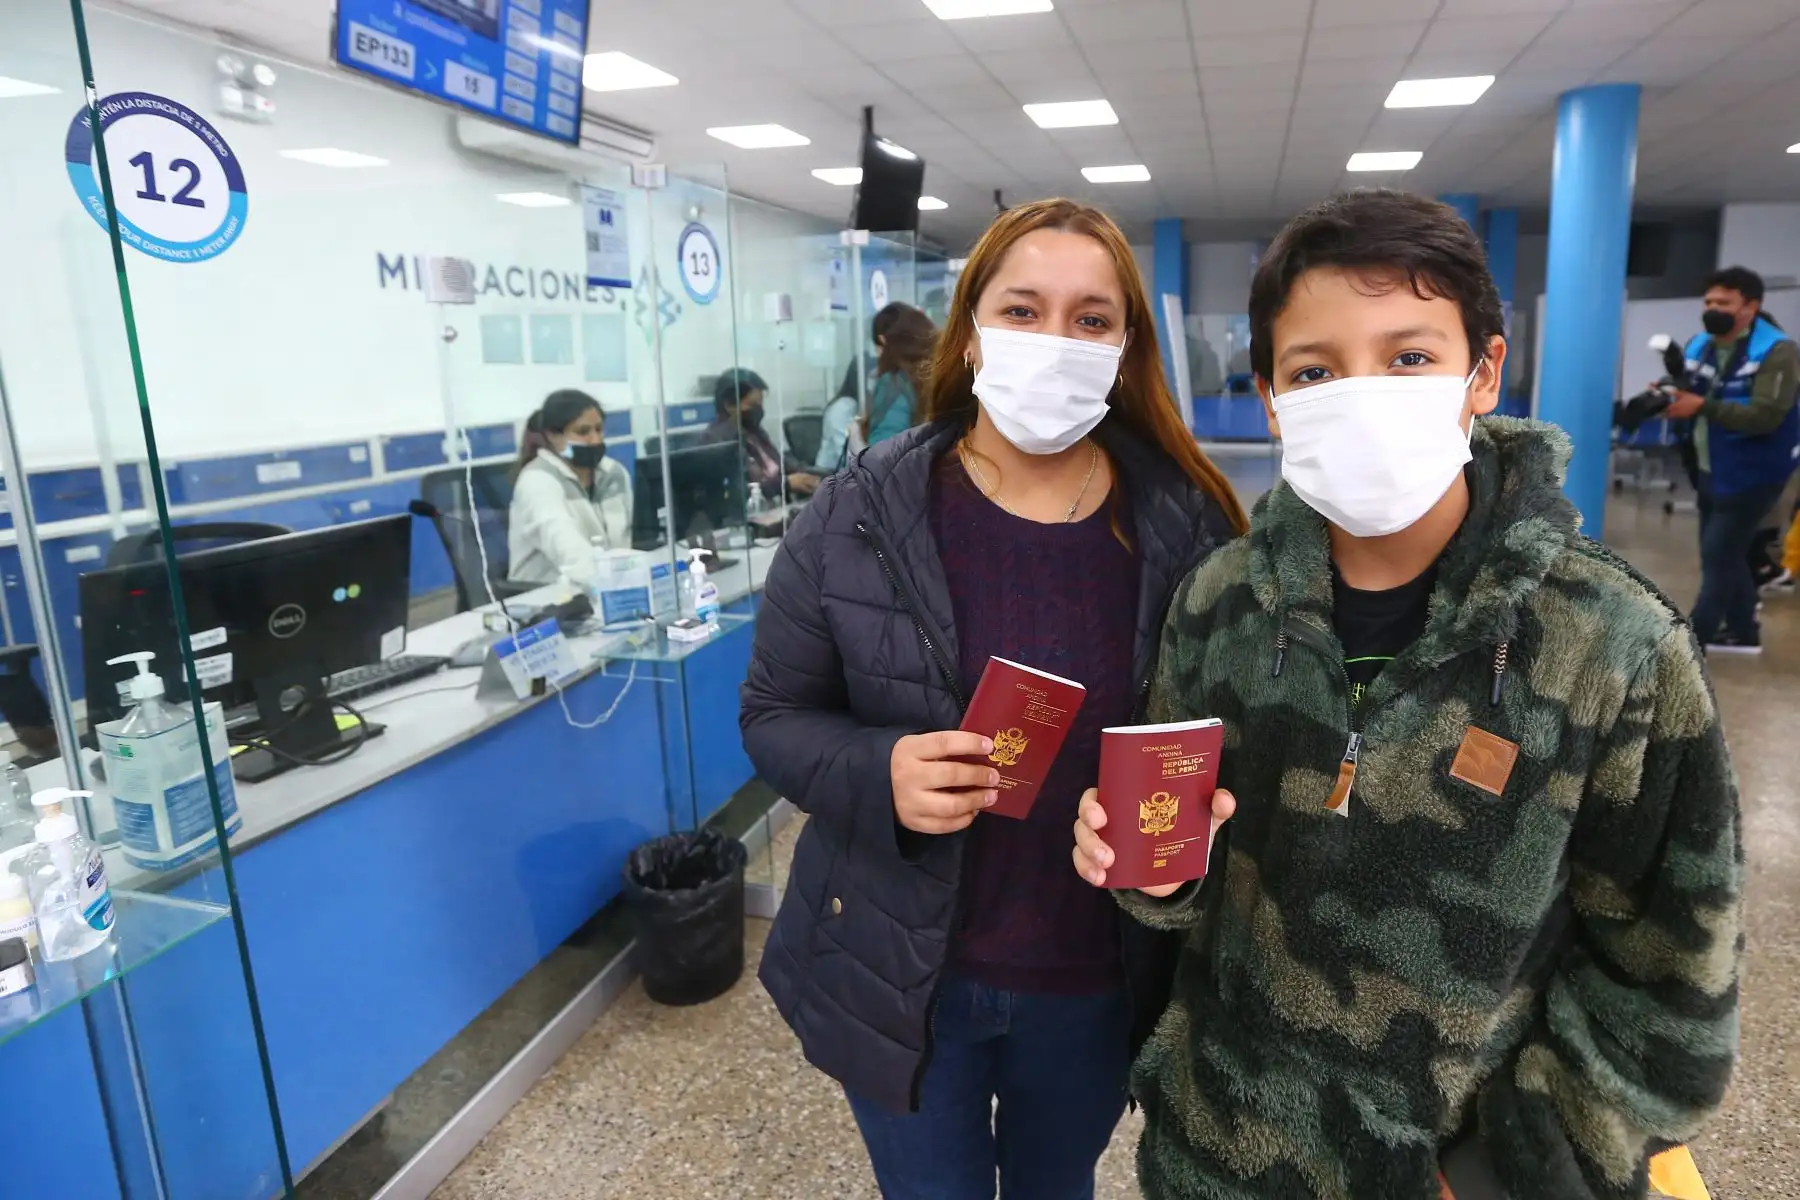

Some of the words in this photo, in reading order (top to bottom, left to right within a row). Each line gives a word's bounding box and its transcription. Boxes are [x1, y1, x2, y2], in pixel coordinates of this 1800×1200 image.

[356, 32, 410, 67] EP133
[121, 99, 136, 109] LA
[180, 111, 196, 125] DE
[201, 126, 229, 157] METRO
[129, 150, 205, 208] 12
[118, 223, 142, 246] OUR
[142, 240, 192, 259] DISTANCE
[690, 251, 711, 276] 13
[376, 252, 616, 304] MIACIONES
[1142, 743, 1182, 753] COMUNIDAD
[1157, 750, 1183, 759] ANDINA
[1161, 768, 1177, 776] DEL
[1178, 763, 1198, 774] PERÚ
[1162, 756, 1204, 769] REPÚBLICA
[1154, 843, 1185, 853] PASAPORTE
[1154, 849, 1181, 858] PASSPORT
